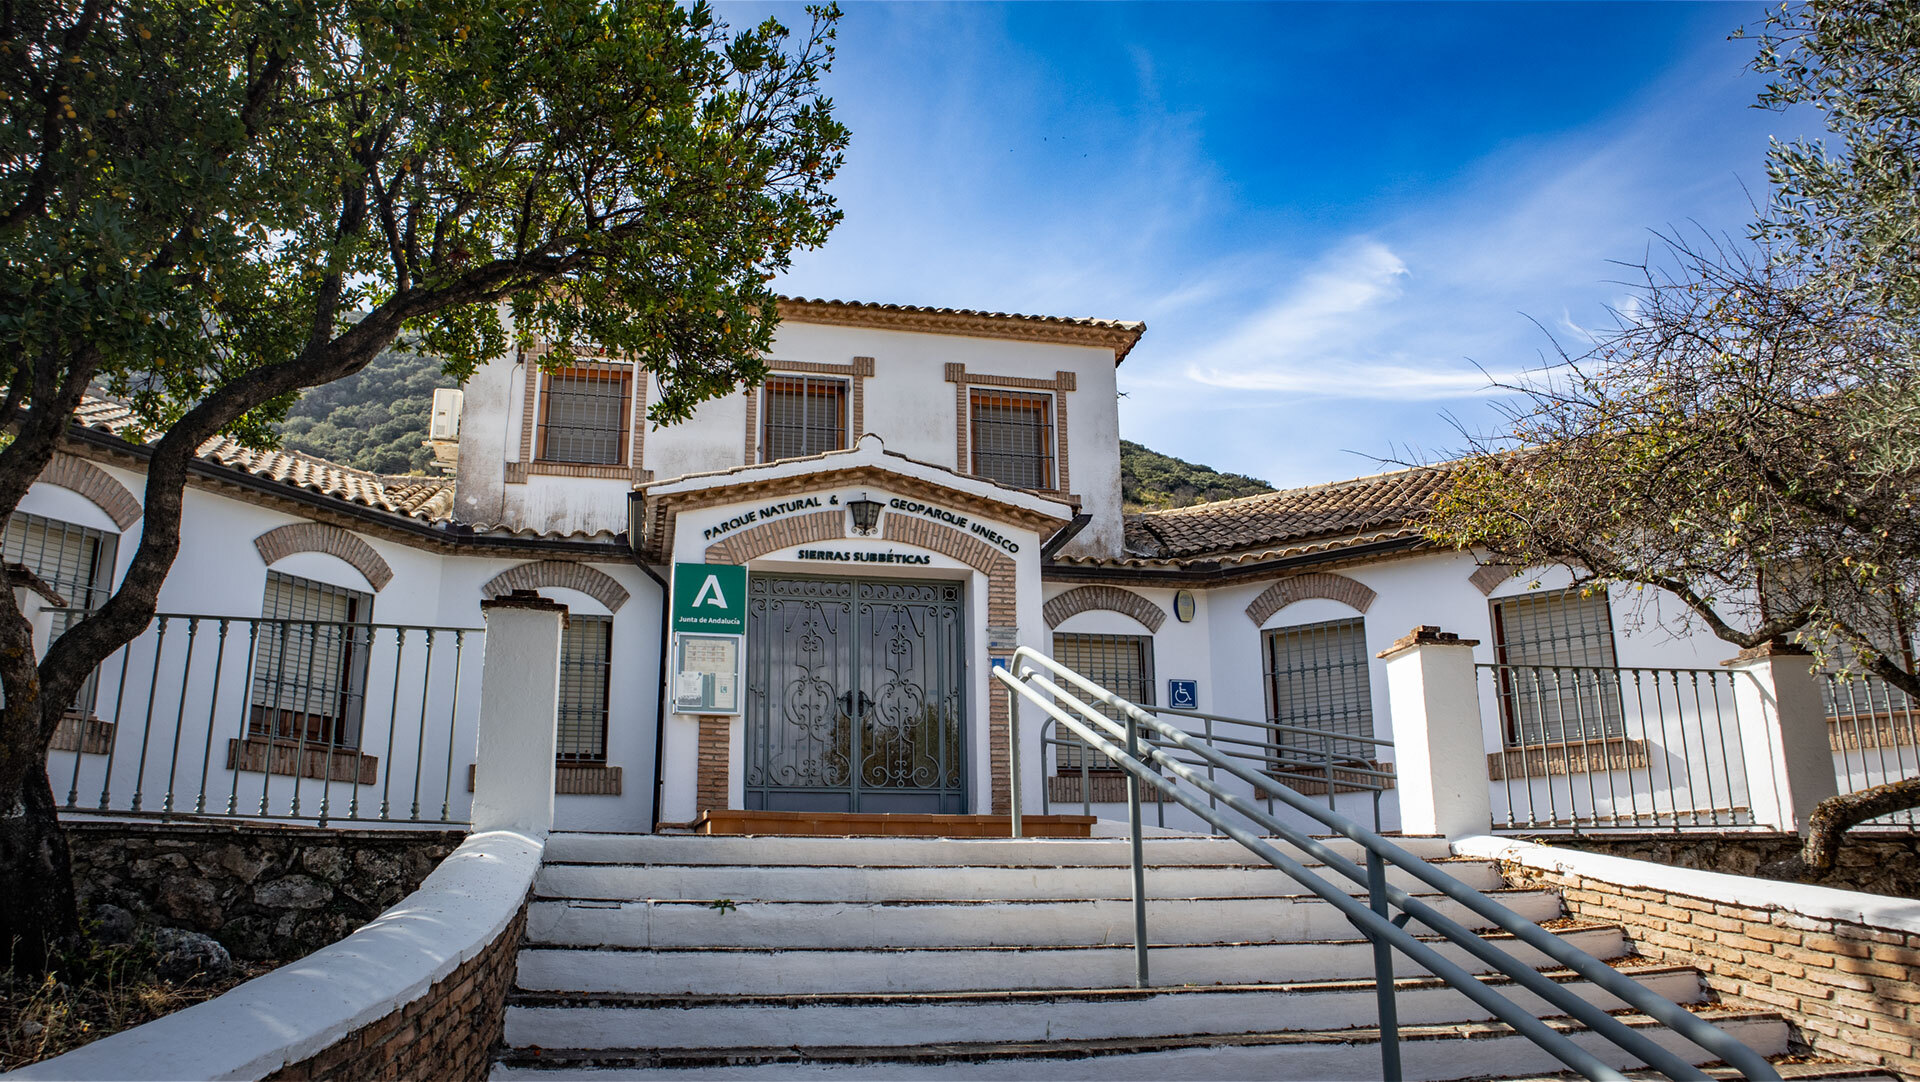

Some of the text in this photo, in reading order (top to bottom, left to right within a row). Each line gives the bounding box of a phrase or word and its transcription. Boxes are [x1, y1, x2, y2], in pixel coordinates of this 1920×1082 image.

[704, 495, 1020, 554] PARQUE NATURAL & GEOPARQUE UNESCO
[798, 549, 930, 565] SIERRAS SUBBÉTICAS
[708, 617, 740, 625] Andalucía
